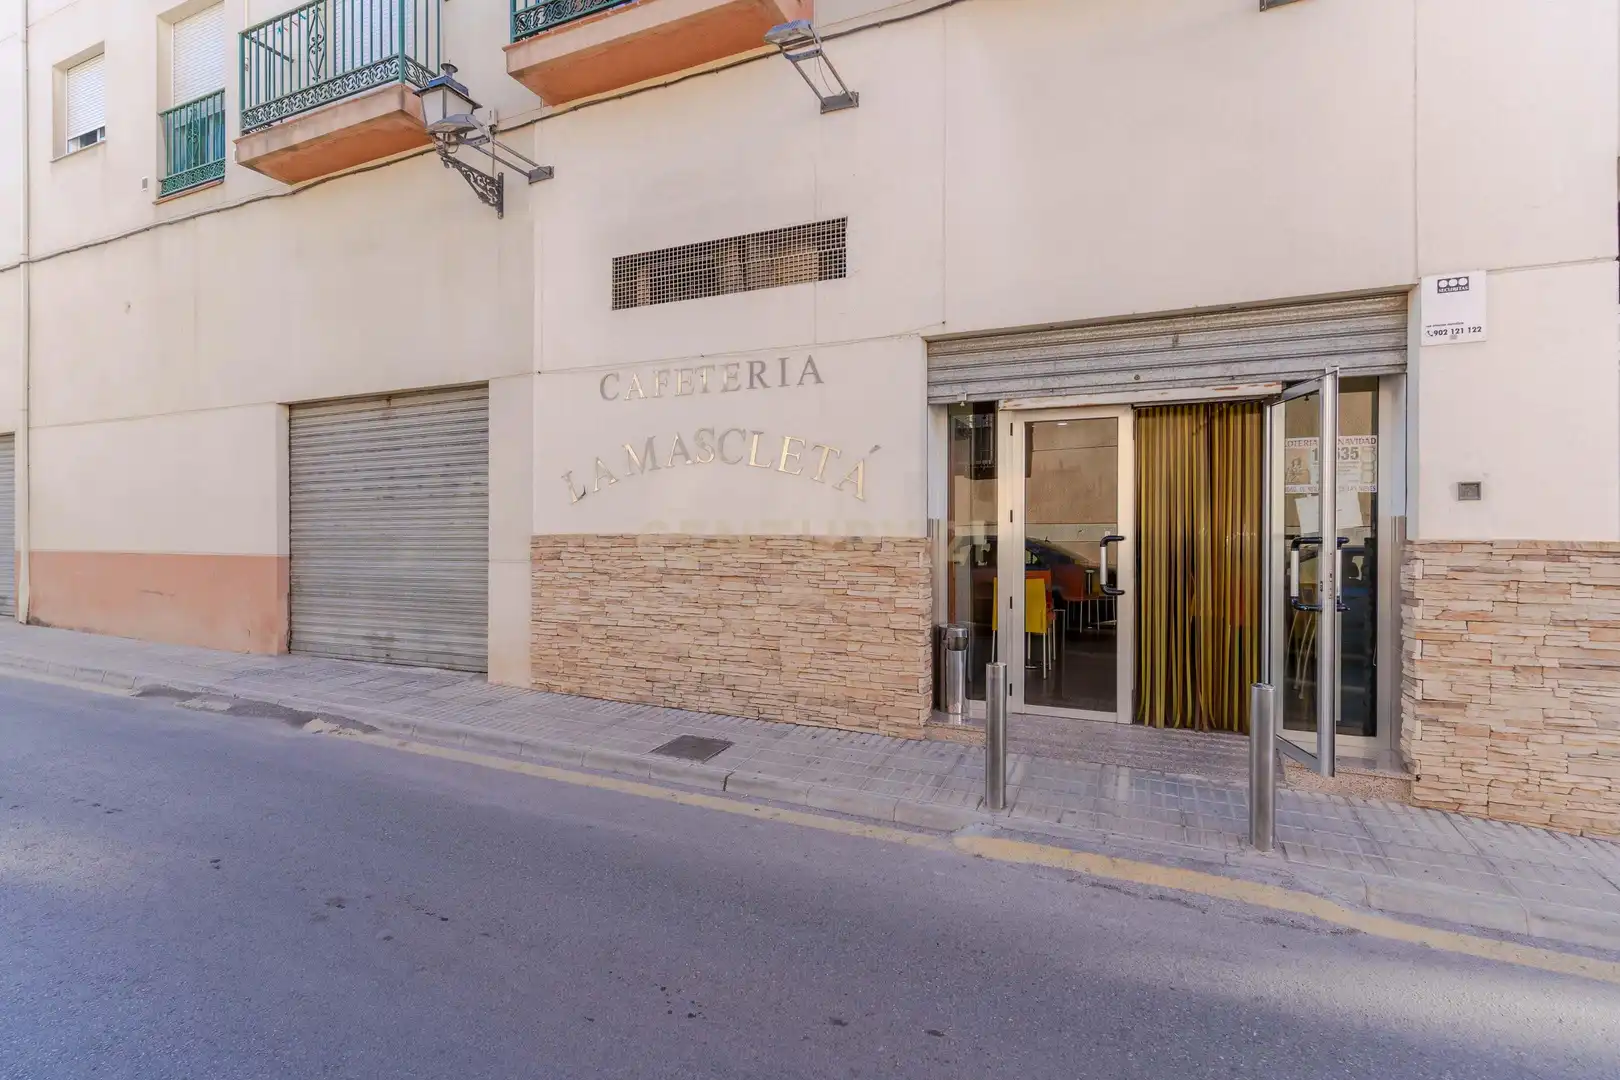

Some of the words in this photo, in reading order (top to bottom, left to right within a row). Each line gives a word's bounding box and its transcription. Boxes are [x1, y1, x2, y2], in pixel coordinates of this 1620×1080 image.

[1433, 329, 1448, 337] 902
[600, 354, 824, 401] CAFETERIA
[1338, 437, 1377, 446] NAVIDAD
[561, 456, 619, 505] LA
[622, 427, 881, 502] MASCLETÁ
